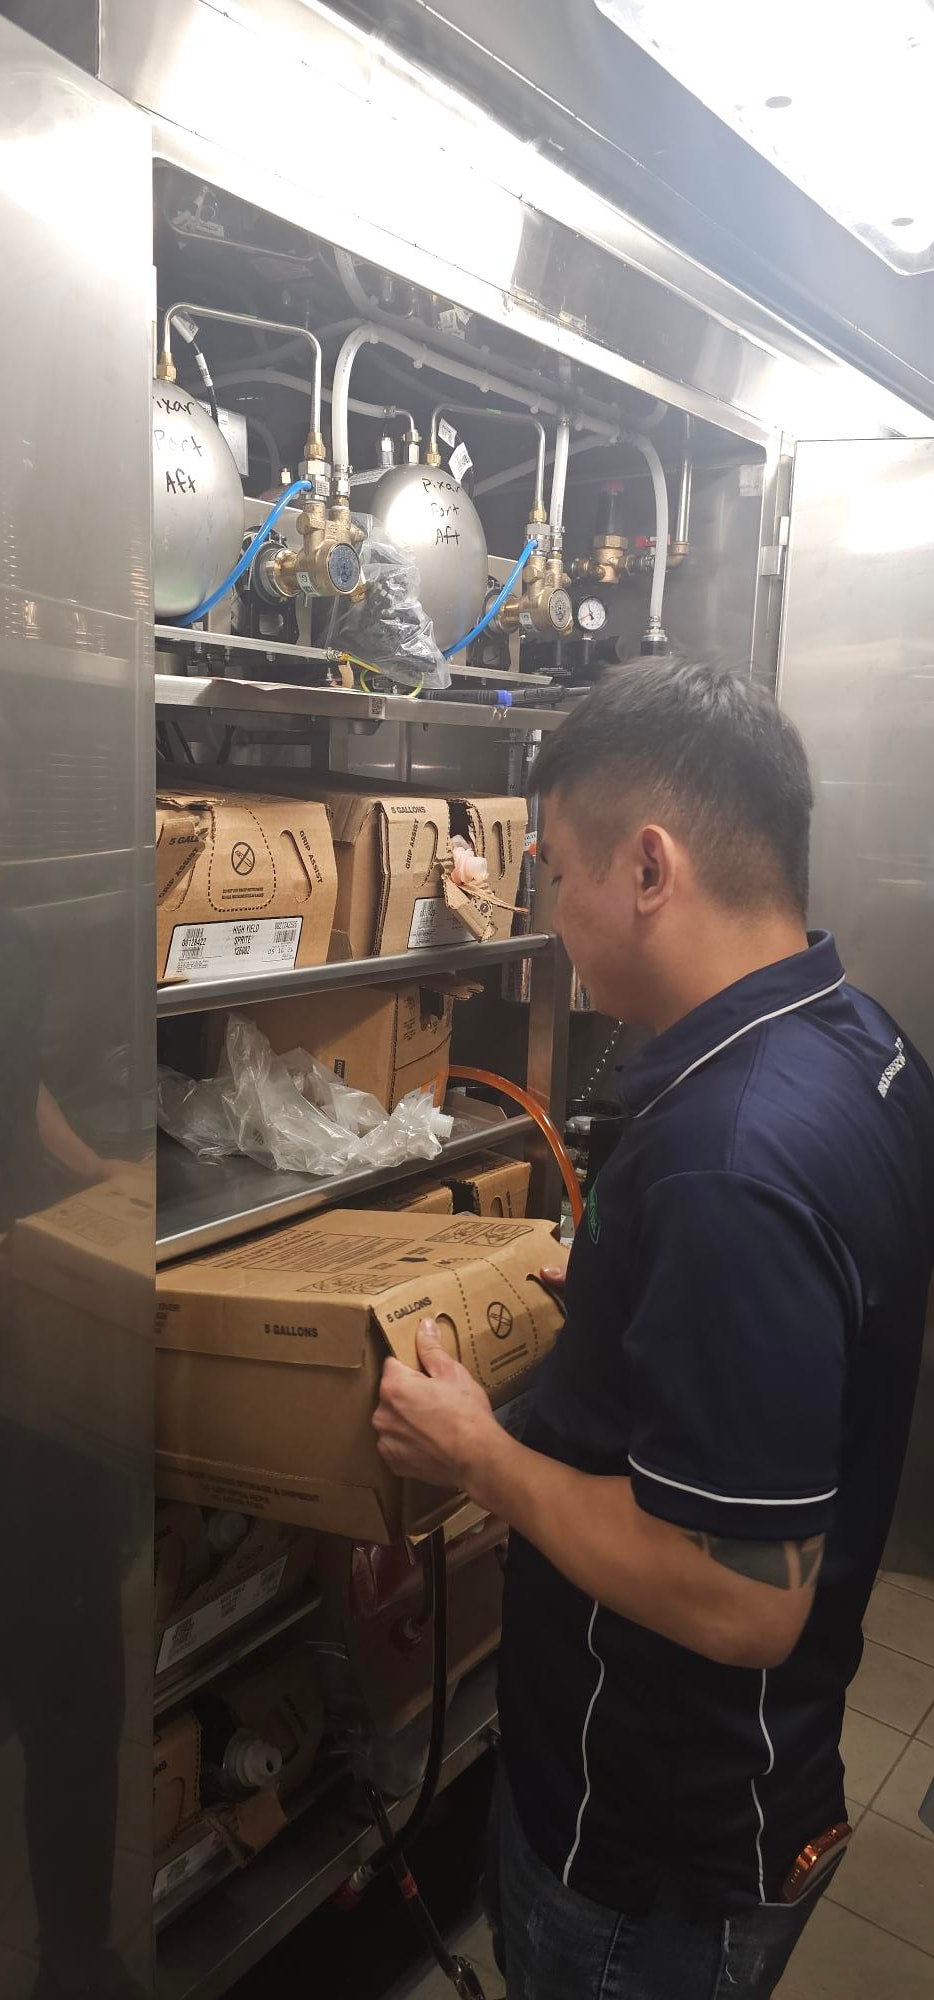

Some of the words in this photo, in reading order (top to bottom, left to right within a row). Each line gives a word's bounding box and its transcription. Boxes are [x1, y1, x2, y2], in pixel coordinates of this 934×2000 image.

[153, 396, 195, 415] ixar
[166, 468, 196, 494] Aft
[422, 478, 461, 495] Pixar
[435, 525, 461, 545] Aft
[397, 806, 426, 814] GALLONS
[168, 838, 178, 846] 5
[405, 848, 414, 870] GRIP
[410, 819, 420, 848] ASSIST
[299, 830, 312, 852] GRIP
[308, 854, 323, 883] ASSIST
[386, 1313, 394, 1323] 5
[394, 1296, 433, 1319] GALLONS
[264, 1324, 271, 1334] 5
[273, 1325, 318, 1338] GALLONS
